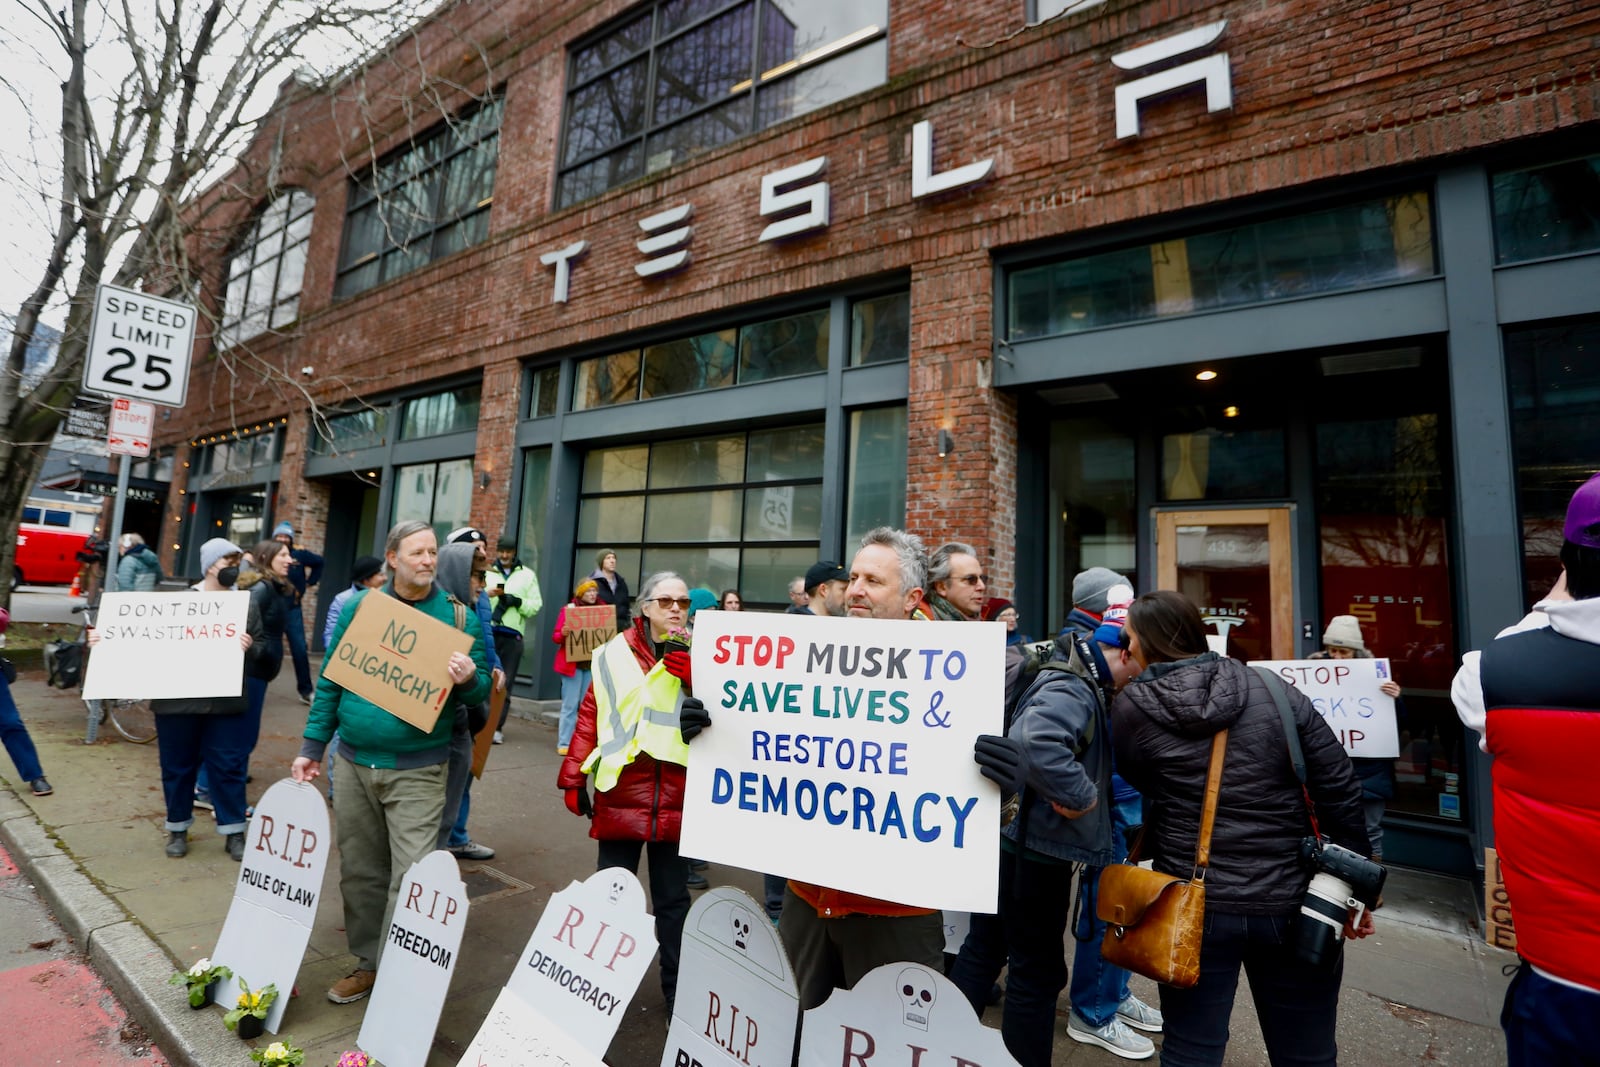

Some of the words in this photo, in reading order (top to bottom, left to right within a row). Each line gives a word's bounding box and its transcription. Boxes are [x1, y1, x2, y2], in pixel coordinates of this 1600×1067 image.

[540, 20, 1233, 302] TESLA
[106, 297, 186, 329] SPEED
[112, 322, 175, 350] LIMIT
[102, 347, 172, 391] 25
[1208, 540, 1236, 553] 435
[187, 601, 224, 616] BUY
[569, 607, 612, 630] STOP
[1199, 607, 1248, 616] TESLA
[1354, 595, 1424, 604] TESLA
[104, 623, 237, 640] SWASTIKARS
[381, 619, 417, 655] NO
[339, 642, 447, 711] OLIGARCHY!
[713, 635, 795, 669] STOP
[806, 643, 912, 679] MUSK
[919, 650, 967, 681] TO
[1280, 666, 1350, 686] STOP
[721, 680, 803, 714] SAVE
[813, 685, 910, 724] LIVES
[922, 690, 952, 728] &
[1312, 697, 1374, 718] SK'S
[752, 730, 908, 775] RESTORE
[711, 768, 979, 848] DEMOCRACY
[255, 815, 317, 869] R.I.P.
[241, 867, 271, 891] RULE
[272, 878, 286, 896] OF
[286, 884, 316, 908] LAW
[389, 923, 451, 970] FREEDOM
[528, 949, 621, 1016] DEMOCRACY
[704, 991, 760, 1067] R.I.P
